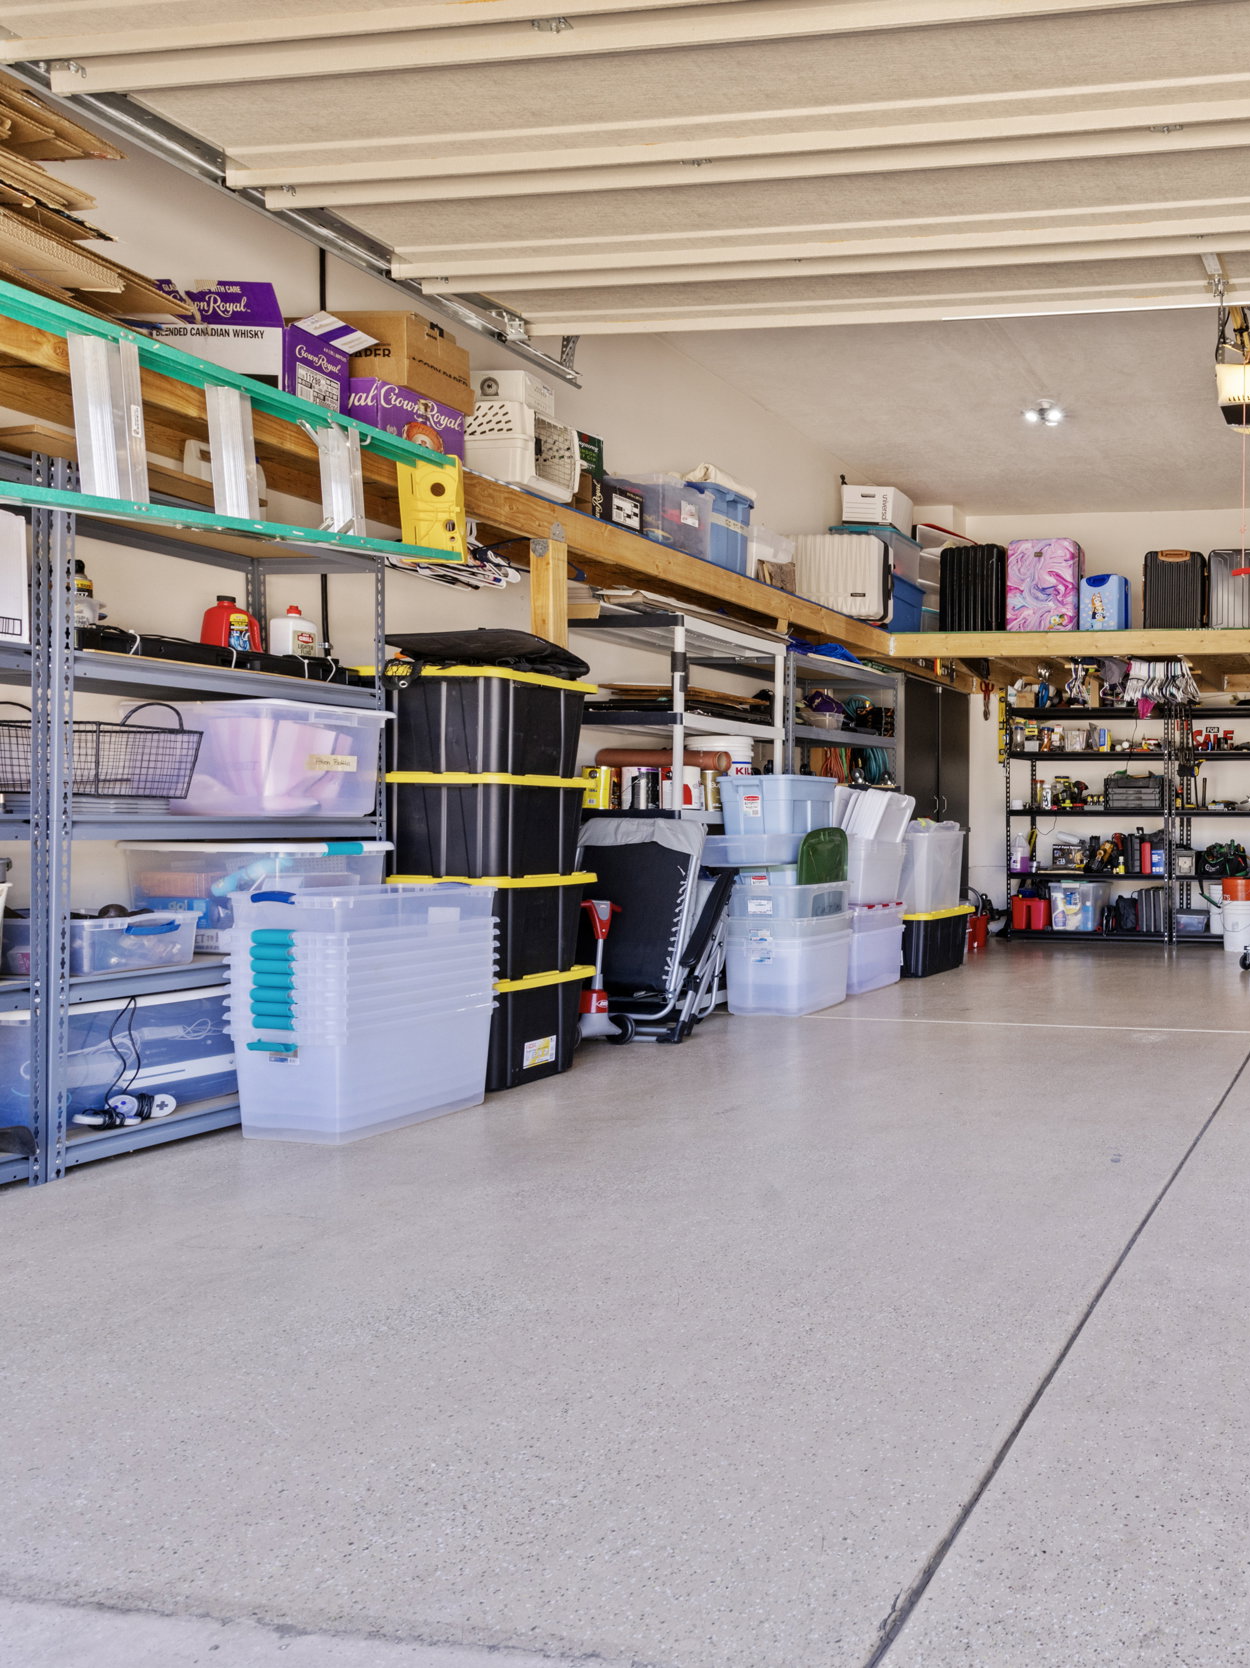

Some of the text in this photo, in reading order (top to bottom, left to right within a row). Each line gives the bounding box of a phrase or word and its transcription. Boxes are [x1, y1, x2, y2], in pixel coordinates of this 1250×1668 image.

[225, 285, 241, 293] CARE
[203, 294, 247, 318] Royal
[155, 327, 264, 339] BLENDED CANADIAN WHISKY
[295, 345, 318, 363] Crown
[315, 354, 341, 373] Royal
[414, 400, 463, 431] Royal
